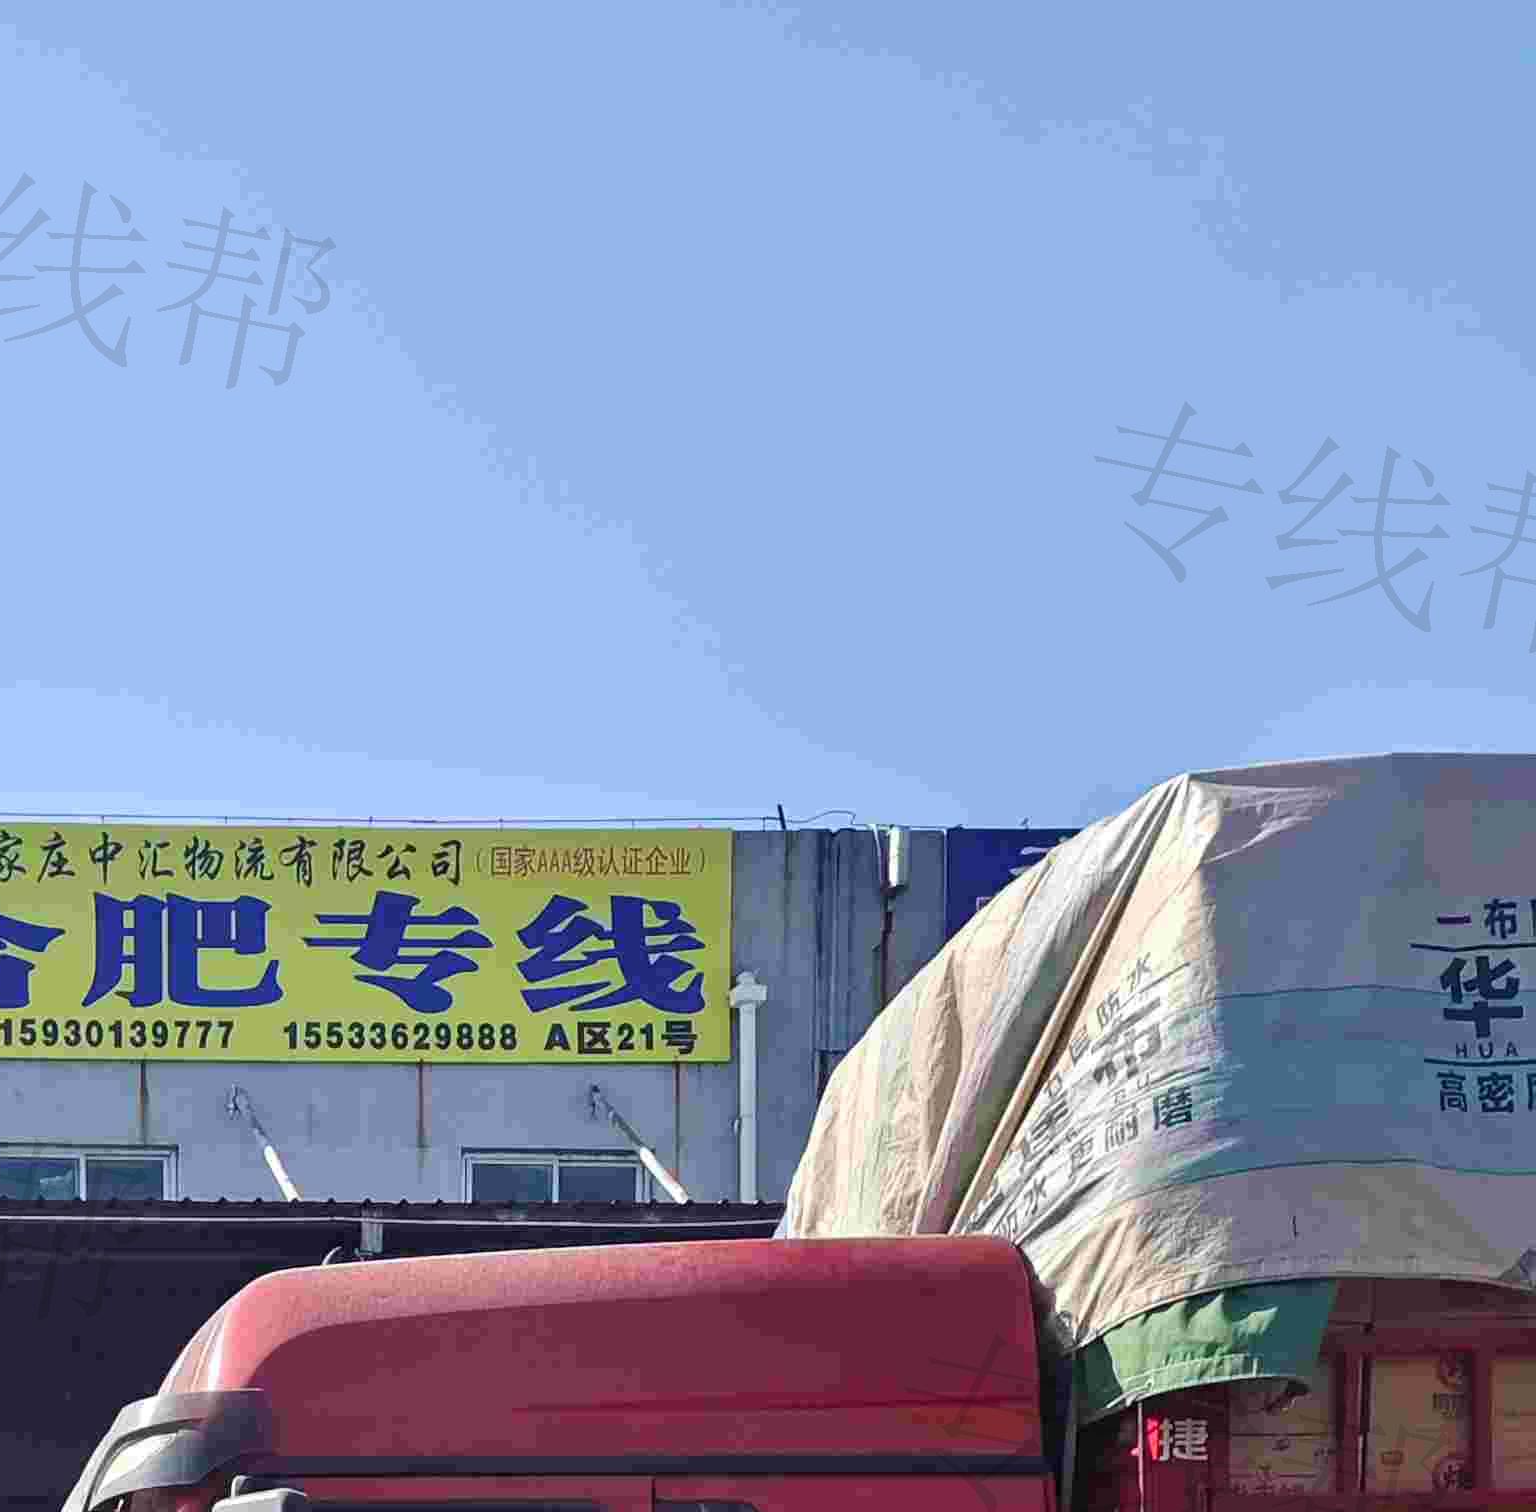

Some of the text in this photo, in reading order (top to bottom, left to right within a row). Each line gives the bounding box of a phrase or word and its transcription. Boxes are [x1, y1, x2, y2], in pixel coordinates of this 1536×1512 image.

[1436, 898, 1536, 939] 一布
[1440, 956, 1523, 1038] 华
[0, 1018, 235, 1051] 15930139777
[284, 1018, 517, 1052] 15533629888
[544, 1020, 698, 1055] A区21号
[1436, 1066, 1536, 1114] 高密
